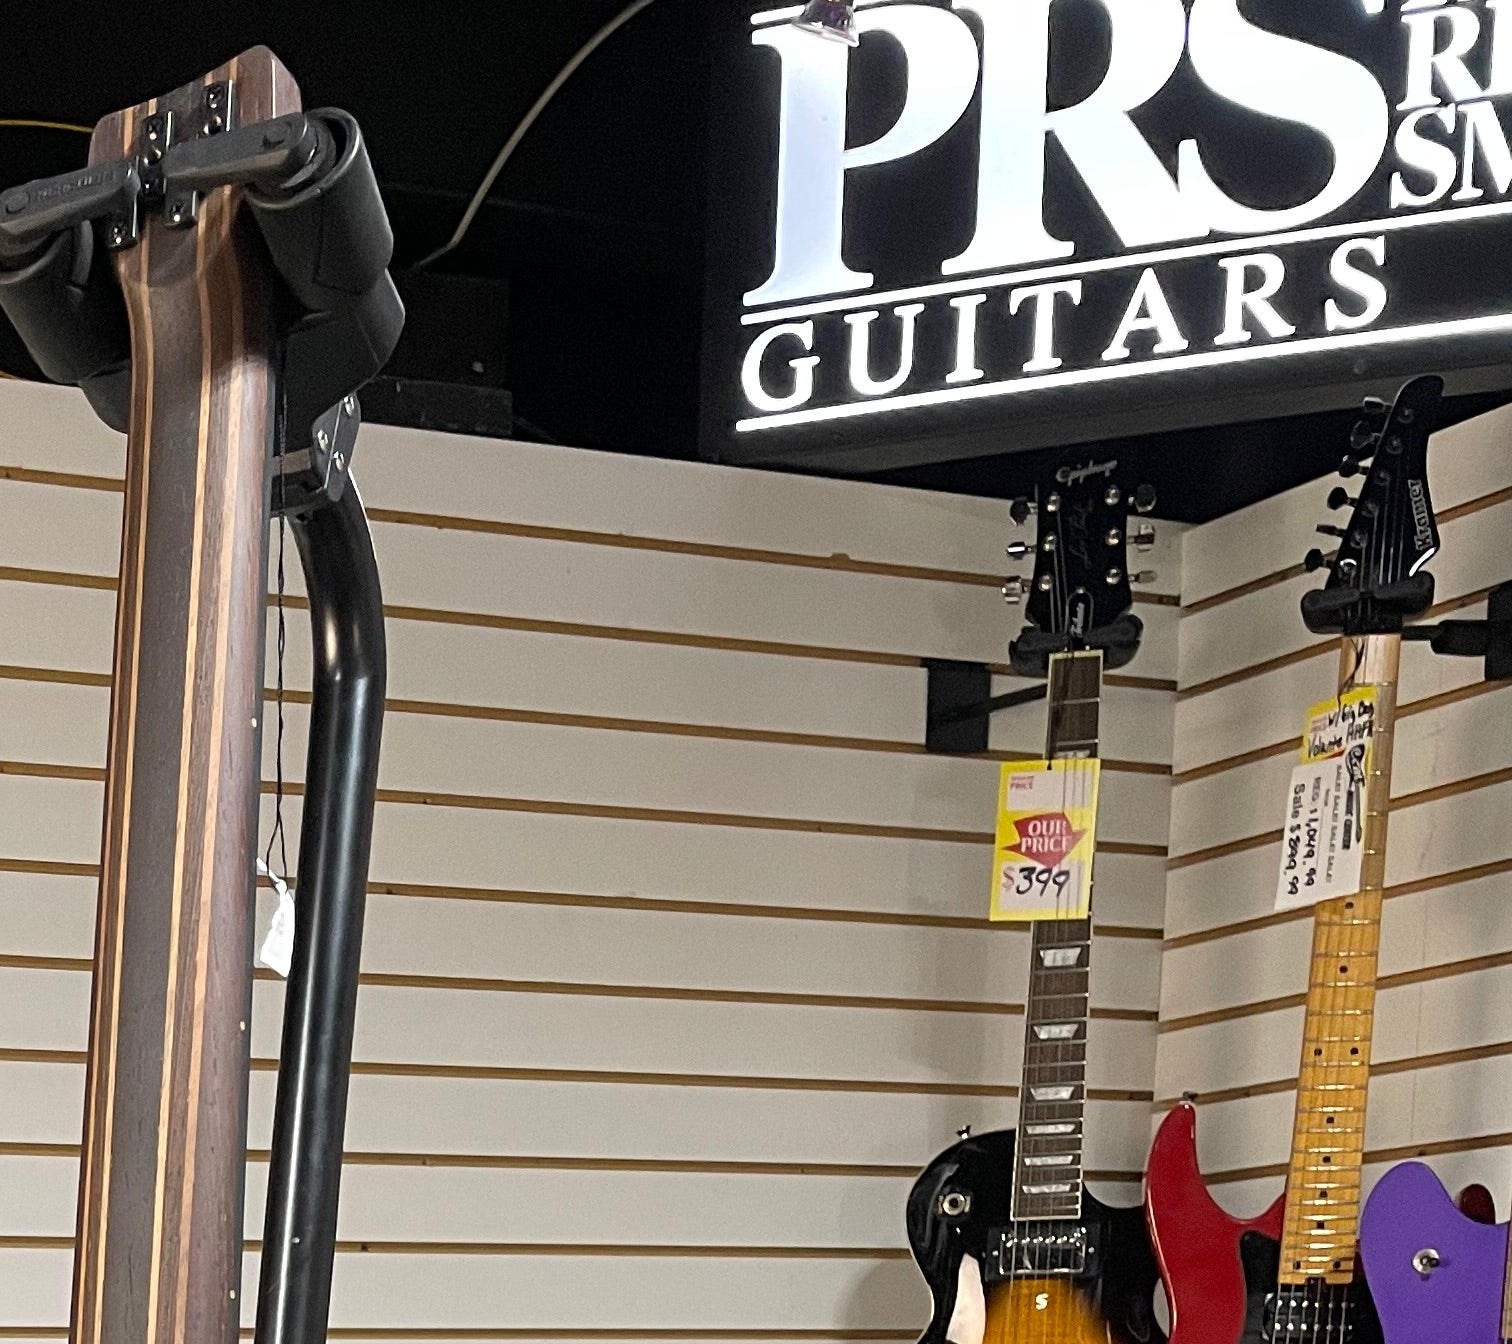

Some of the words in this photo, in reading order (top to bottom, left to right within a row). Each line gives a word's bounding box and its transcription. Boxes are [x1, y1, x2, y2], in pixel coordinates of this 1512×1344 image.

[742, 0, 1389, 306] PRS
[740, 234, 1388, 413] GUITARS
[1407, 479, 1434, 551] Kramer
[1291, 783, 1306, 820] Sale
[1020, 835, 1073, 854] PRICE
[1028, 819, 1068, 837] OUR
[1002, 866, 1070, 898] $399
